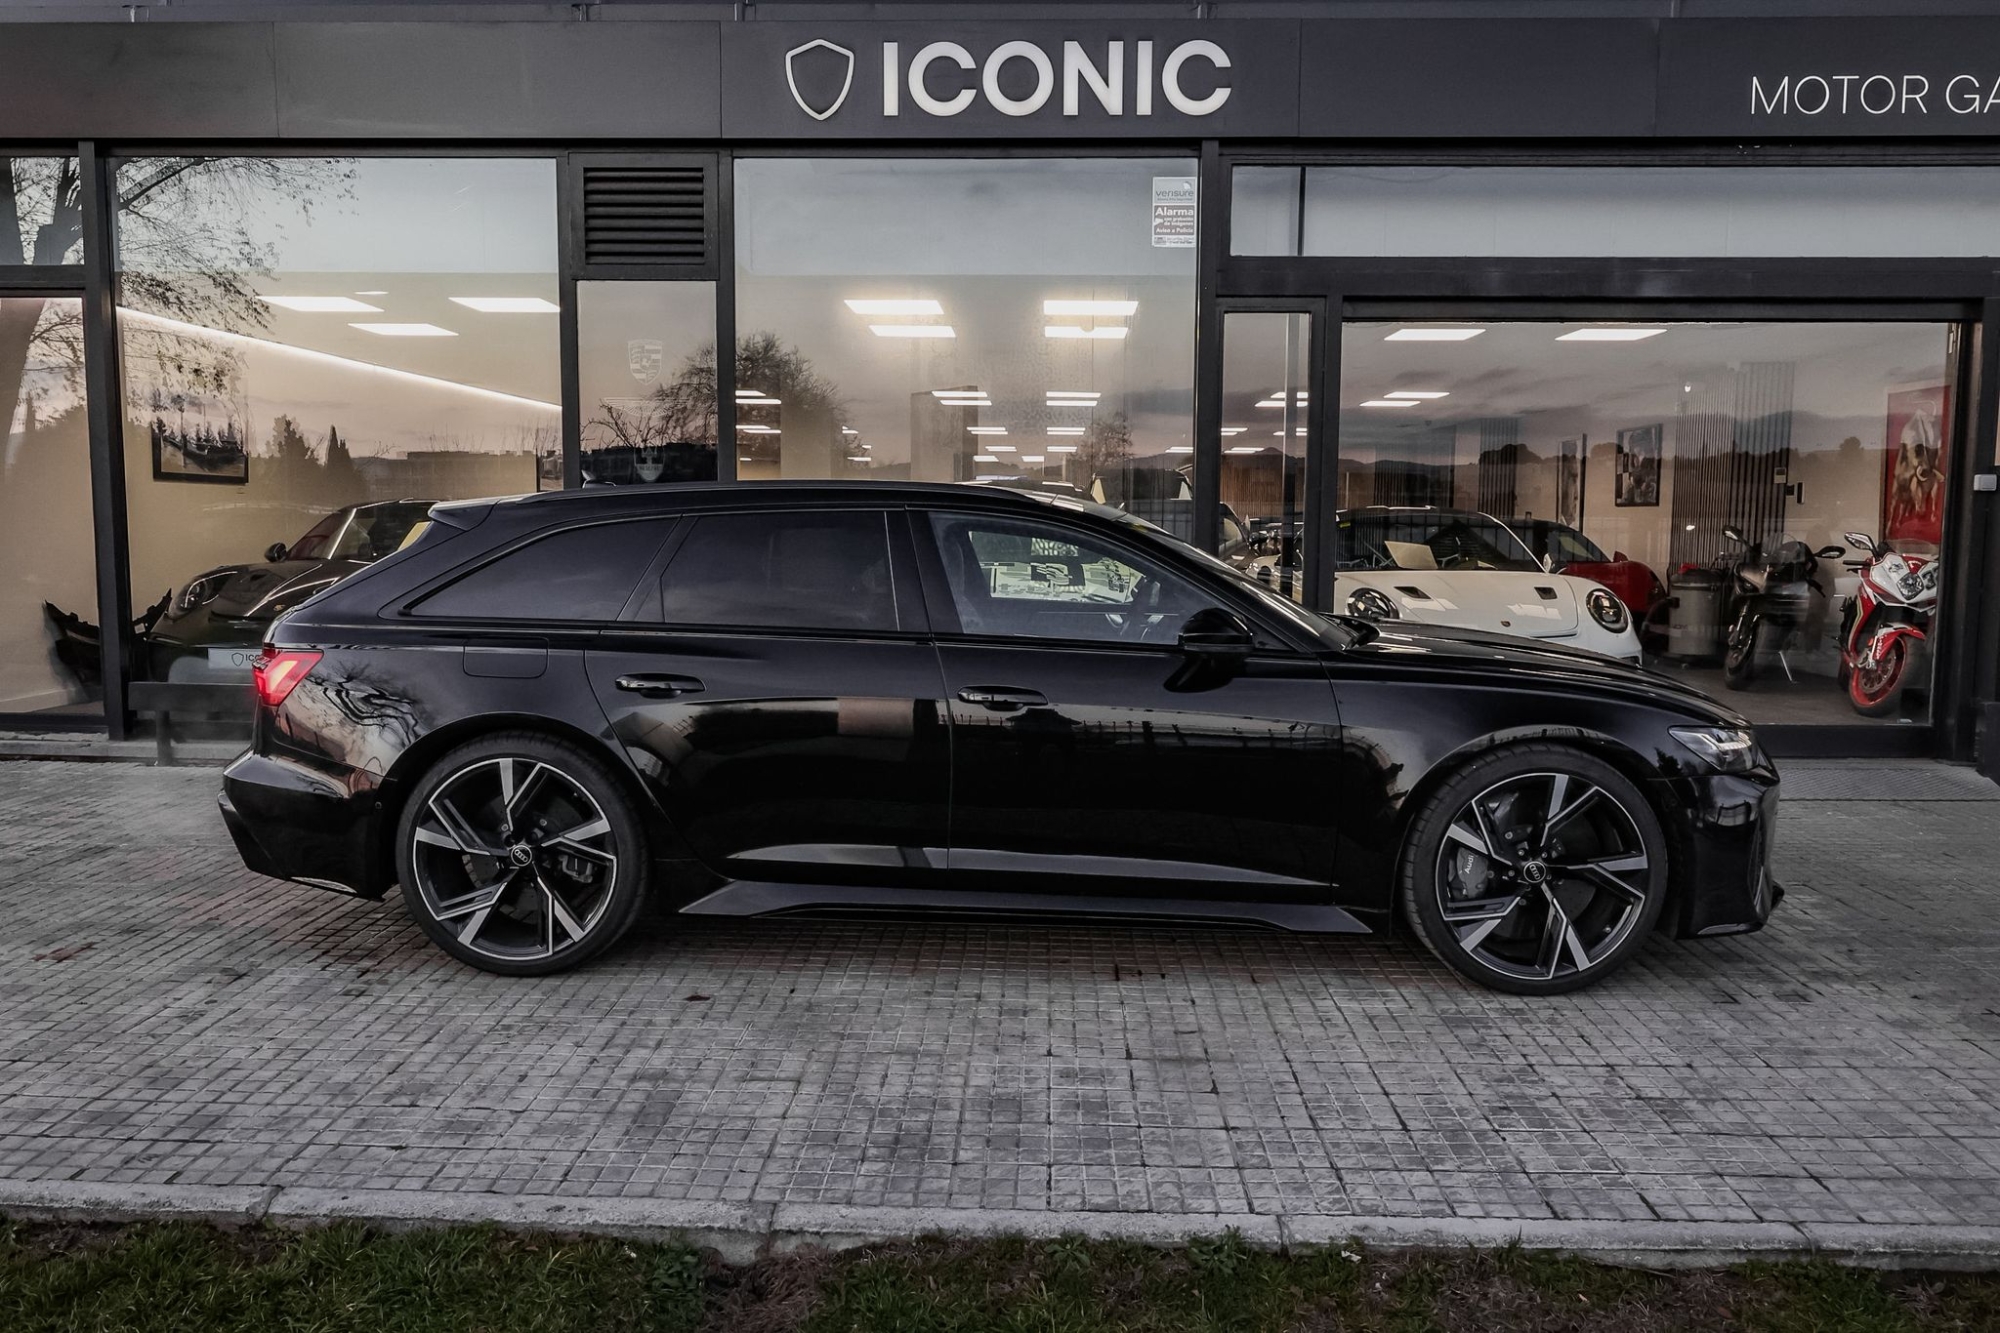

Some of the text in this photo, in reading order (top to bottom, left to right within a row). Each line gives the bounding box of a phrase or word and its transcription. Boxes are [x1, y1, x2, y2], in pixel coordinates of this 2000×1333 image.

[883, 39, 1232, 117] ICONIC
[1751, 75, 1929, 115] MOTOR
[1156, 206, 1194, 216] Alarma
[1464, 854, 1474, 874] Audi
